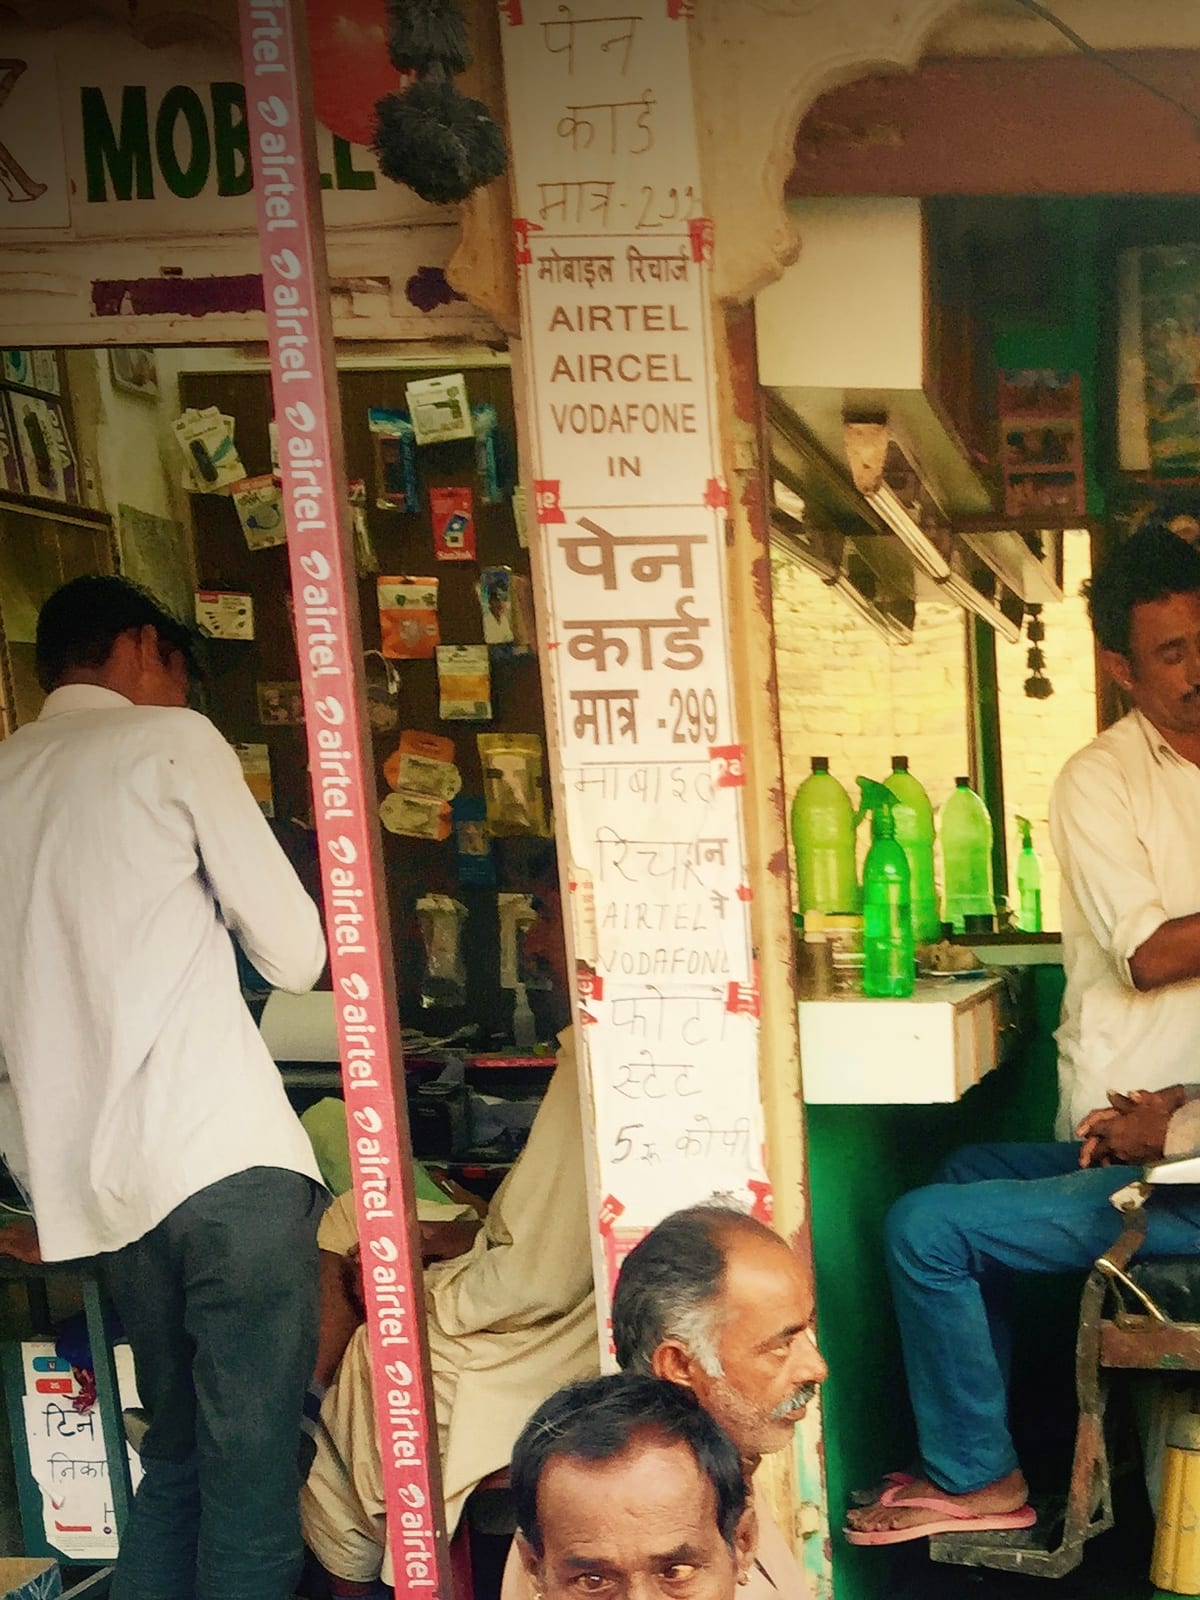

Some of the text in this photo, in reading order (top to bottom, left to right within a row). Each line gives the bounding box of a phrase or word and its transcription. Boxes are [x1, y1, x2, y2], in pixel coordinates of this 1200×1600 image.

[251, 0, 288, 77] irtel
[259, 132, 298, 232] airtel
[537, 244, 690, 289] मोबाइल रिचार्ज
[273, 284, 313, 383] airtel
[549, 304, 689, 332] AIRTEL
[551, 353, 693, 383] AIRCEL
[551, 403, 697, 434] VODAFONE
[288, 436, 327, 532] airtel
[607, 455, 641, 477] IN
[557, 516, 708, 591] पेन
[303, 584, 342, 678] airtel
[562, 595, 711, 672] कार्ड
[569, 688, 639, 746] मात्र
[317, 729, 354, 820] airtel
[329, 868, 368, 956] airtel
[602, 902, 707, 931] AIRTEL
[342, 1006, 380, 1090] airtel
[356, 1137, 394, 1221] airtel
[373, 1266, 410, 1348] airtel
[387, 1389, 422, 1469] airtel
[400, 1512, 435, 1589] airtel
